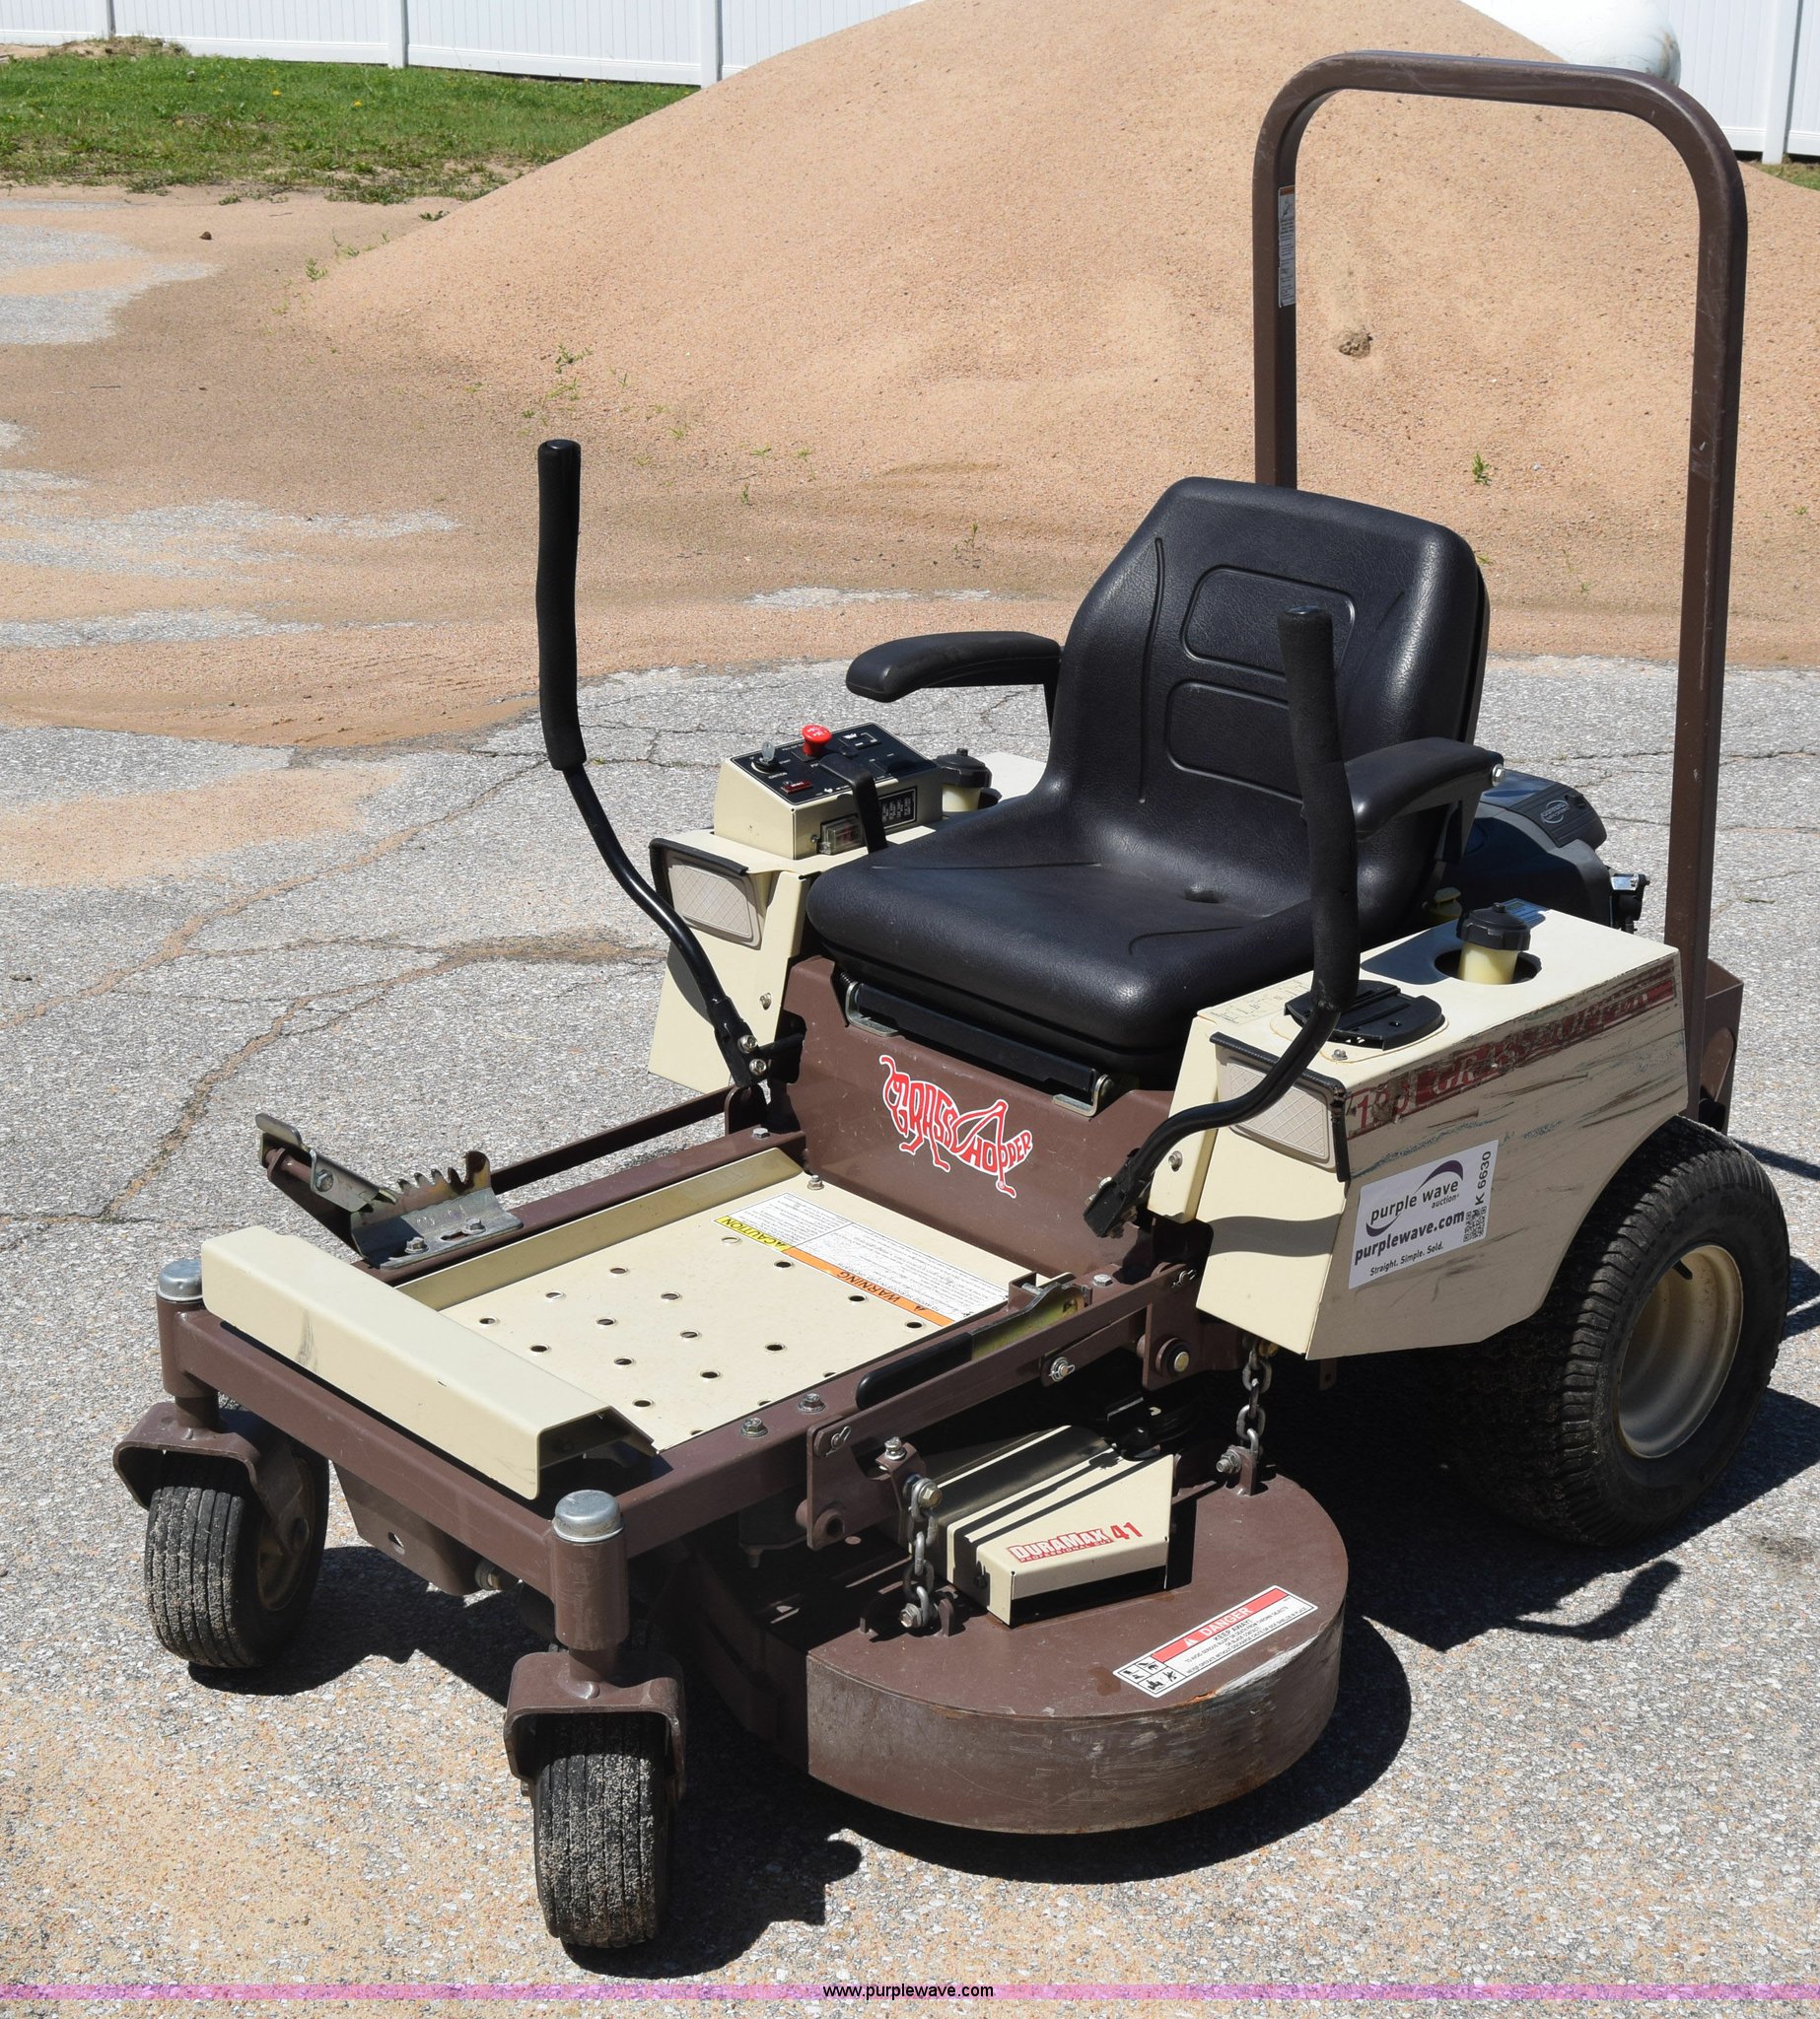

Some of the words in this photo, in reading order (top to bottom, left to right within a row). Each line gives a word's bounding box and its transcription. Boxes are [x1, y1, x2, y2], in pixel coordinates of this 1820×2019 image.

[1478, 1150, 1492, 1190] 6630
[1370, 1194, 1417, 1225] purple
[1422, 1180, 1459, 1203] wave
[1431, 1195, 1457, 1209] auction
[1475, 1192, 1485, 1206] K
[721, 1218, 779, 1244] CAUTION
[1354, 1211, 1465, 1266] purplewave.com
[1369, 1255, 1399, 1277] Straight.
[1400, 1247, 1425, 1264] Simple.
[1427, 1240, 1444, 1254] Sold.
[837, 1272, 901, 1302] WARNING
[1110, 1522, 1143, 1540] 41
[1199, 1607, 1253, 1636] DANGER
[1214, 1630, 1231, 1640] KEEP
